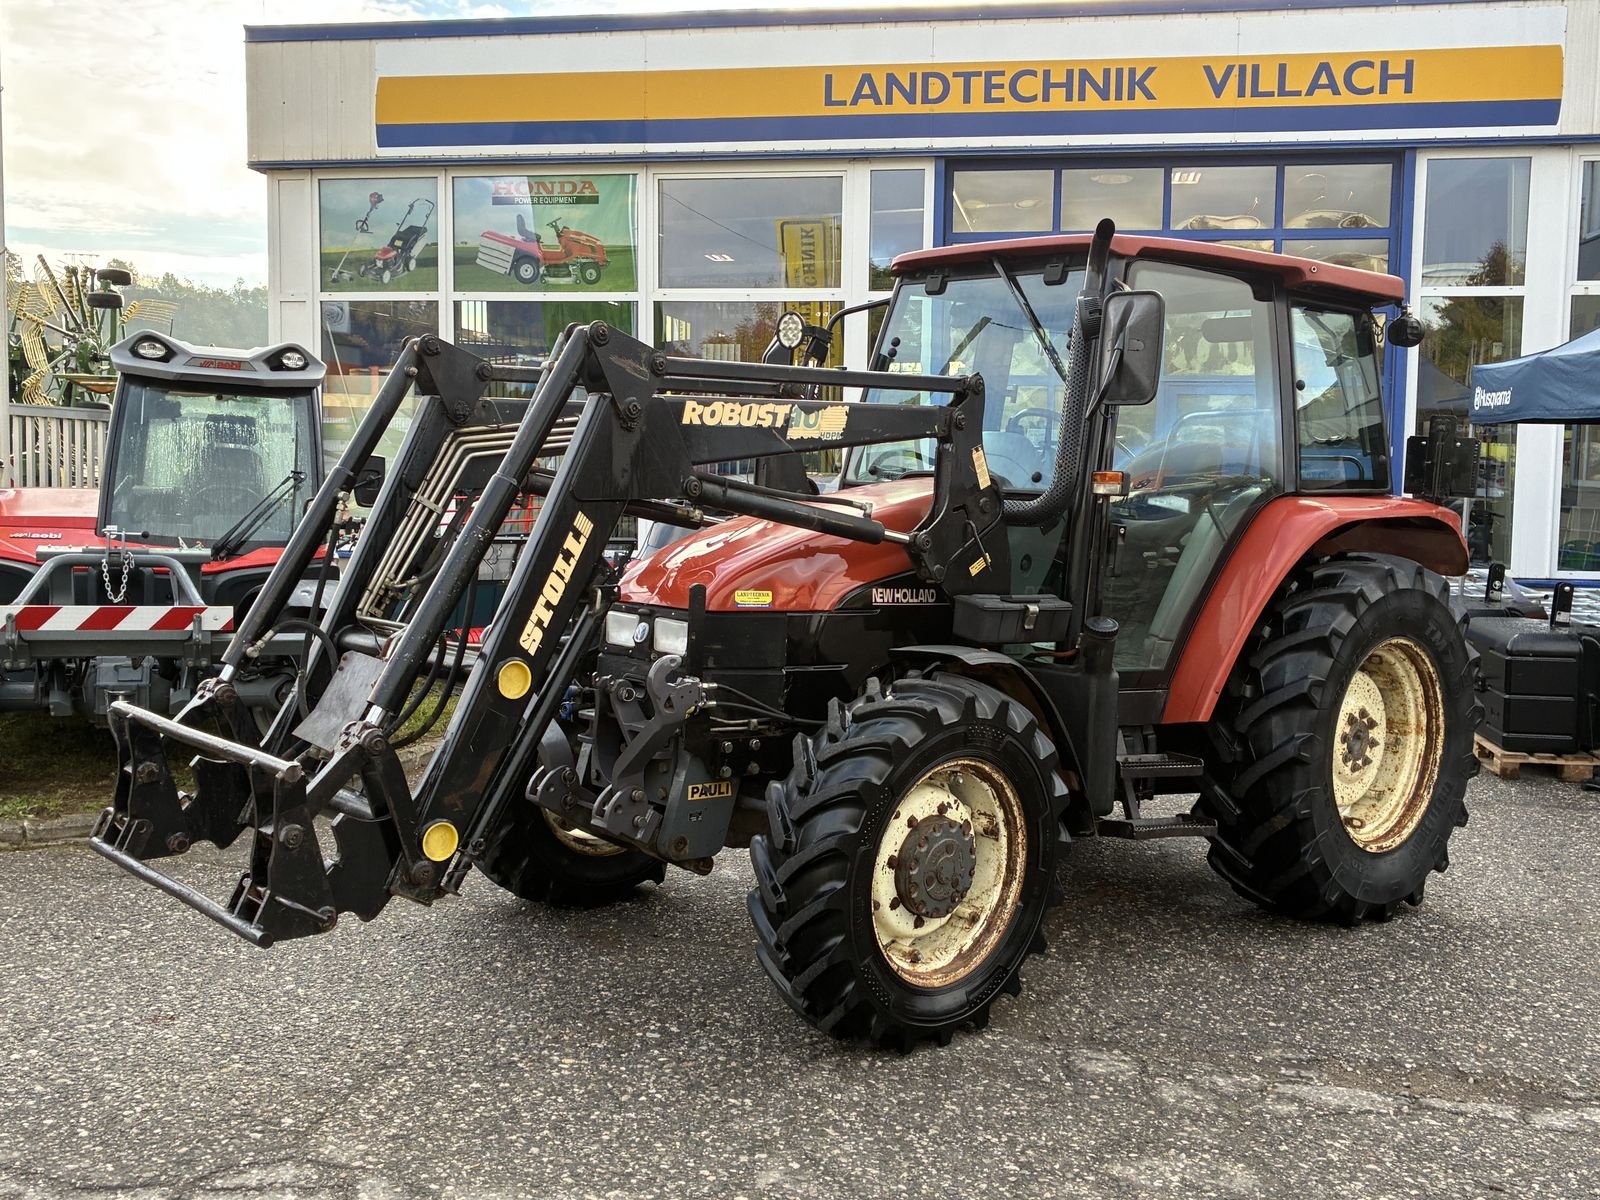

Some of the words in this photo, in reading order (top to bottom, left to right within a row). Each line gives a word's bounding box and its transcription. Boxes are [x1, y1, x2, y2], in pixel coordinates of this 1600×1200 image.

[824, 66, 1158, 107] LANDTECHNIK
[1202, 59, 1415, 99] VILLACH
[493, 180, 599, 195] HONDA
[514, 196, 538, 205] POWER
[539, 195, 577, 204] EQUIPMENT
[1479, 388, 1512, 409] Husqvarna
[682, 400, 791, 428] ROBUST
[519, 531, 588, 656] STOLL
[872, 588, 893, 603] NEW
[894, 588, 936, 603] HOLLAND
[690, 783, 730, 798] PAULI
